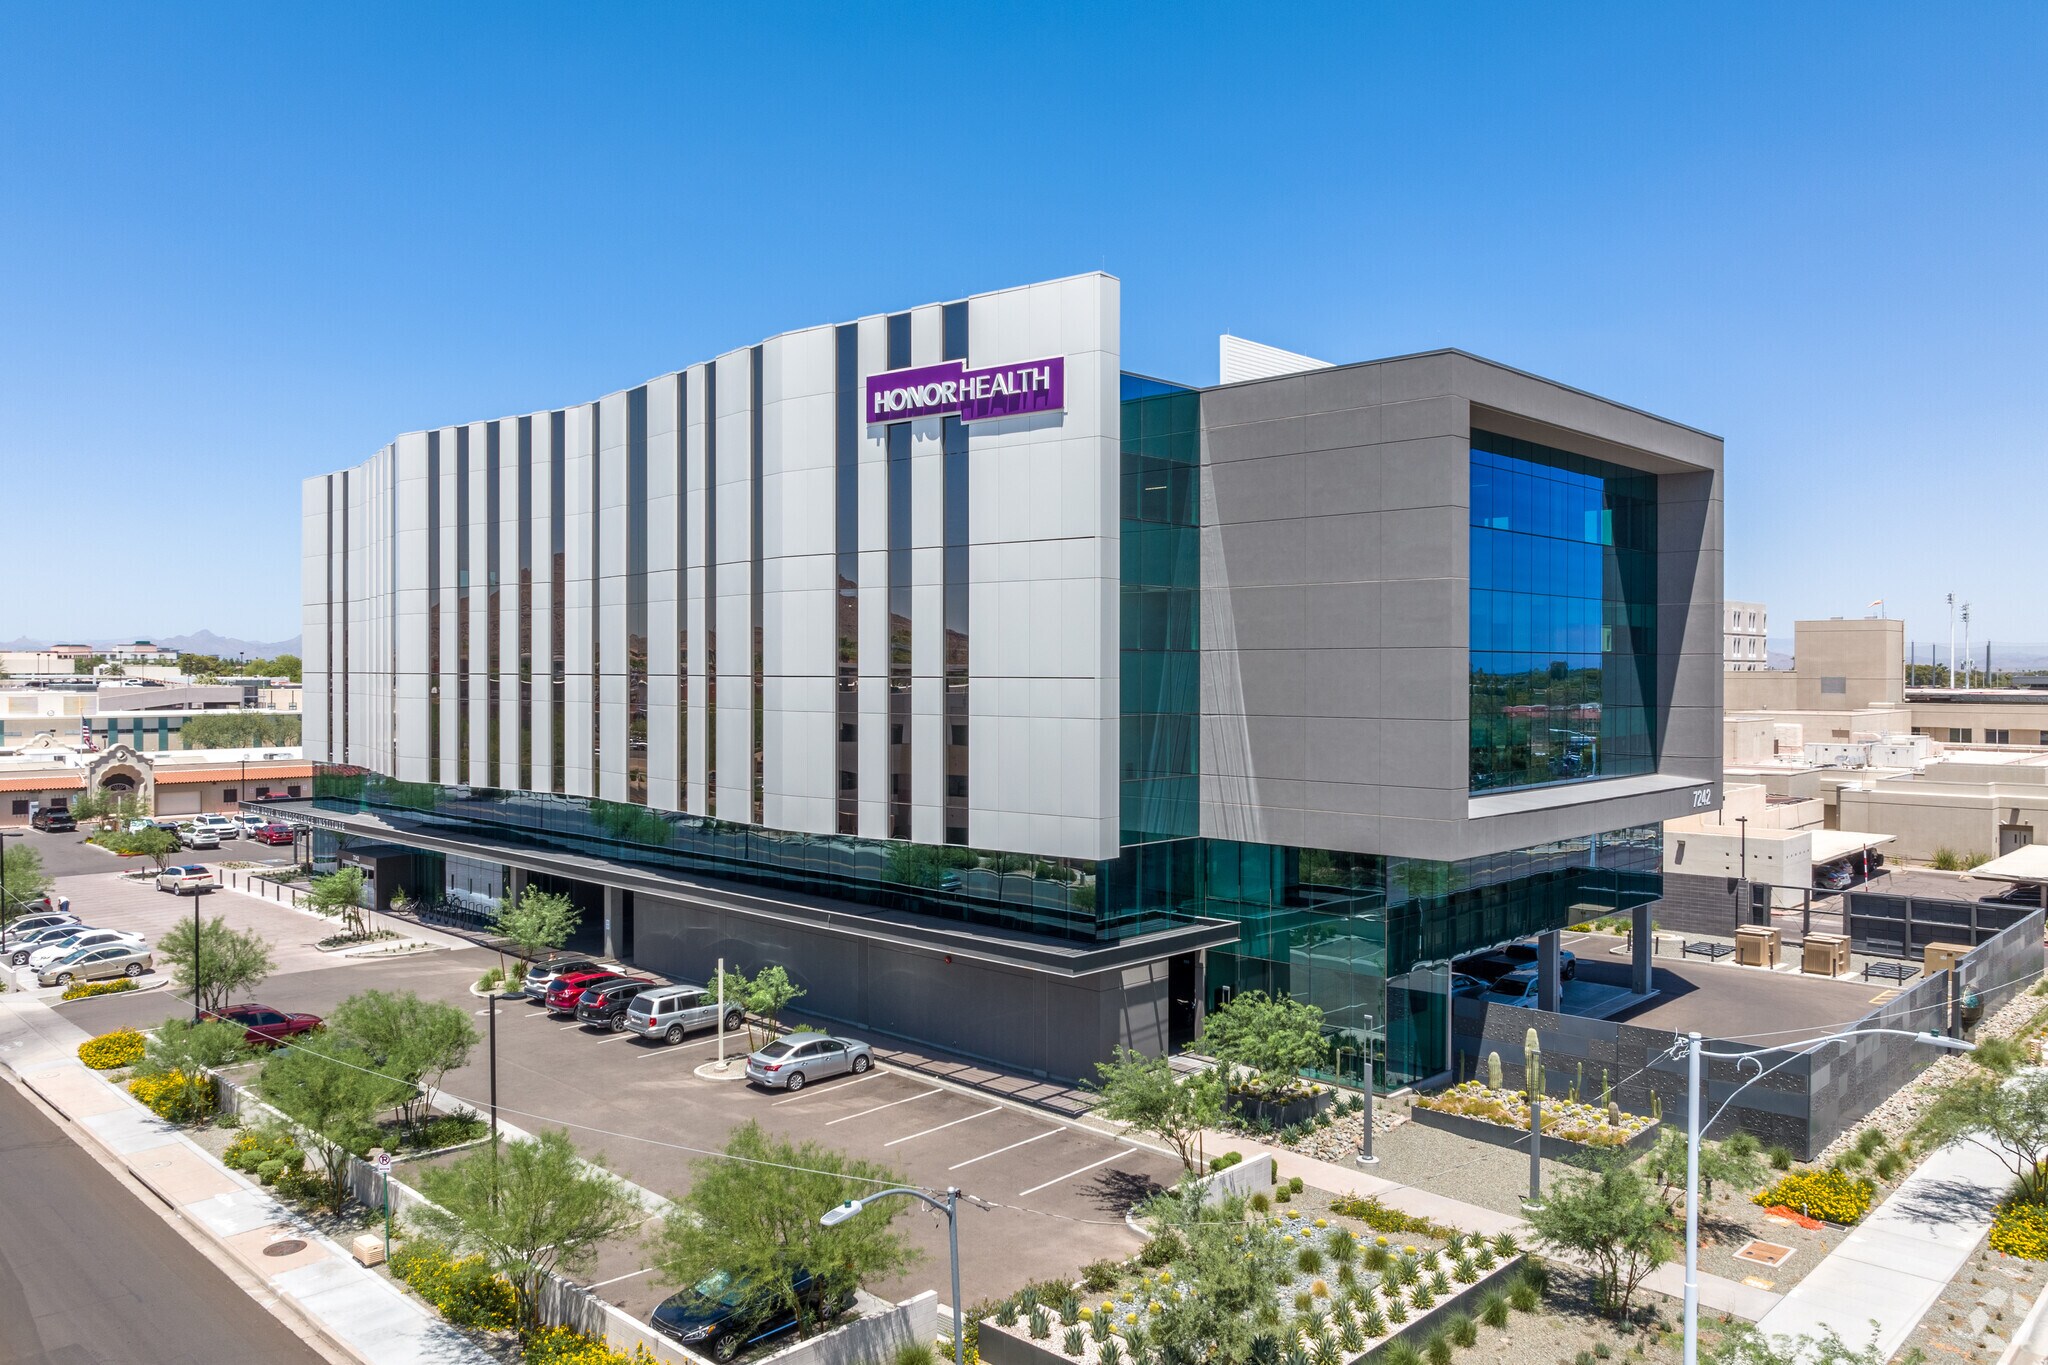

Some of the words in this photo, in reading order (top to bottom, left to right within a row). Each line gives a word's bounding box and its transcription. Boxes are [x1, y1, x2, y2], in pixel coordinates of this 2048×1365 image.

[1693, 789, 1711, 808] 7242
[276, 810, 314, 825] NEUROSCIENCE
[317, 818, 345, 831] INSTITUTE
